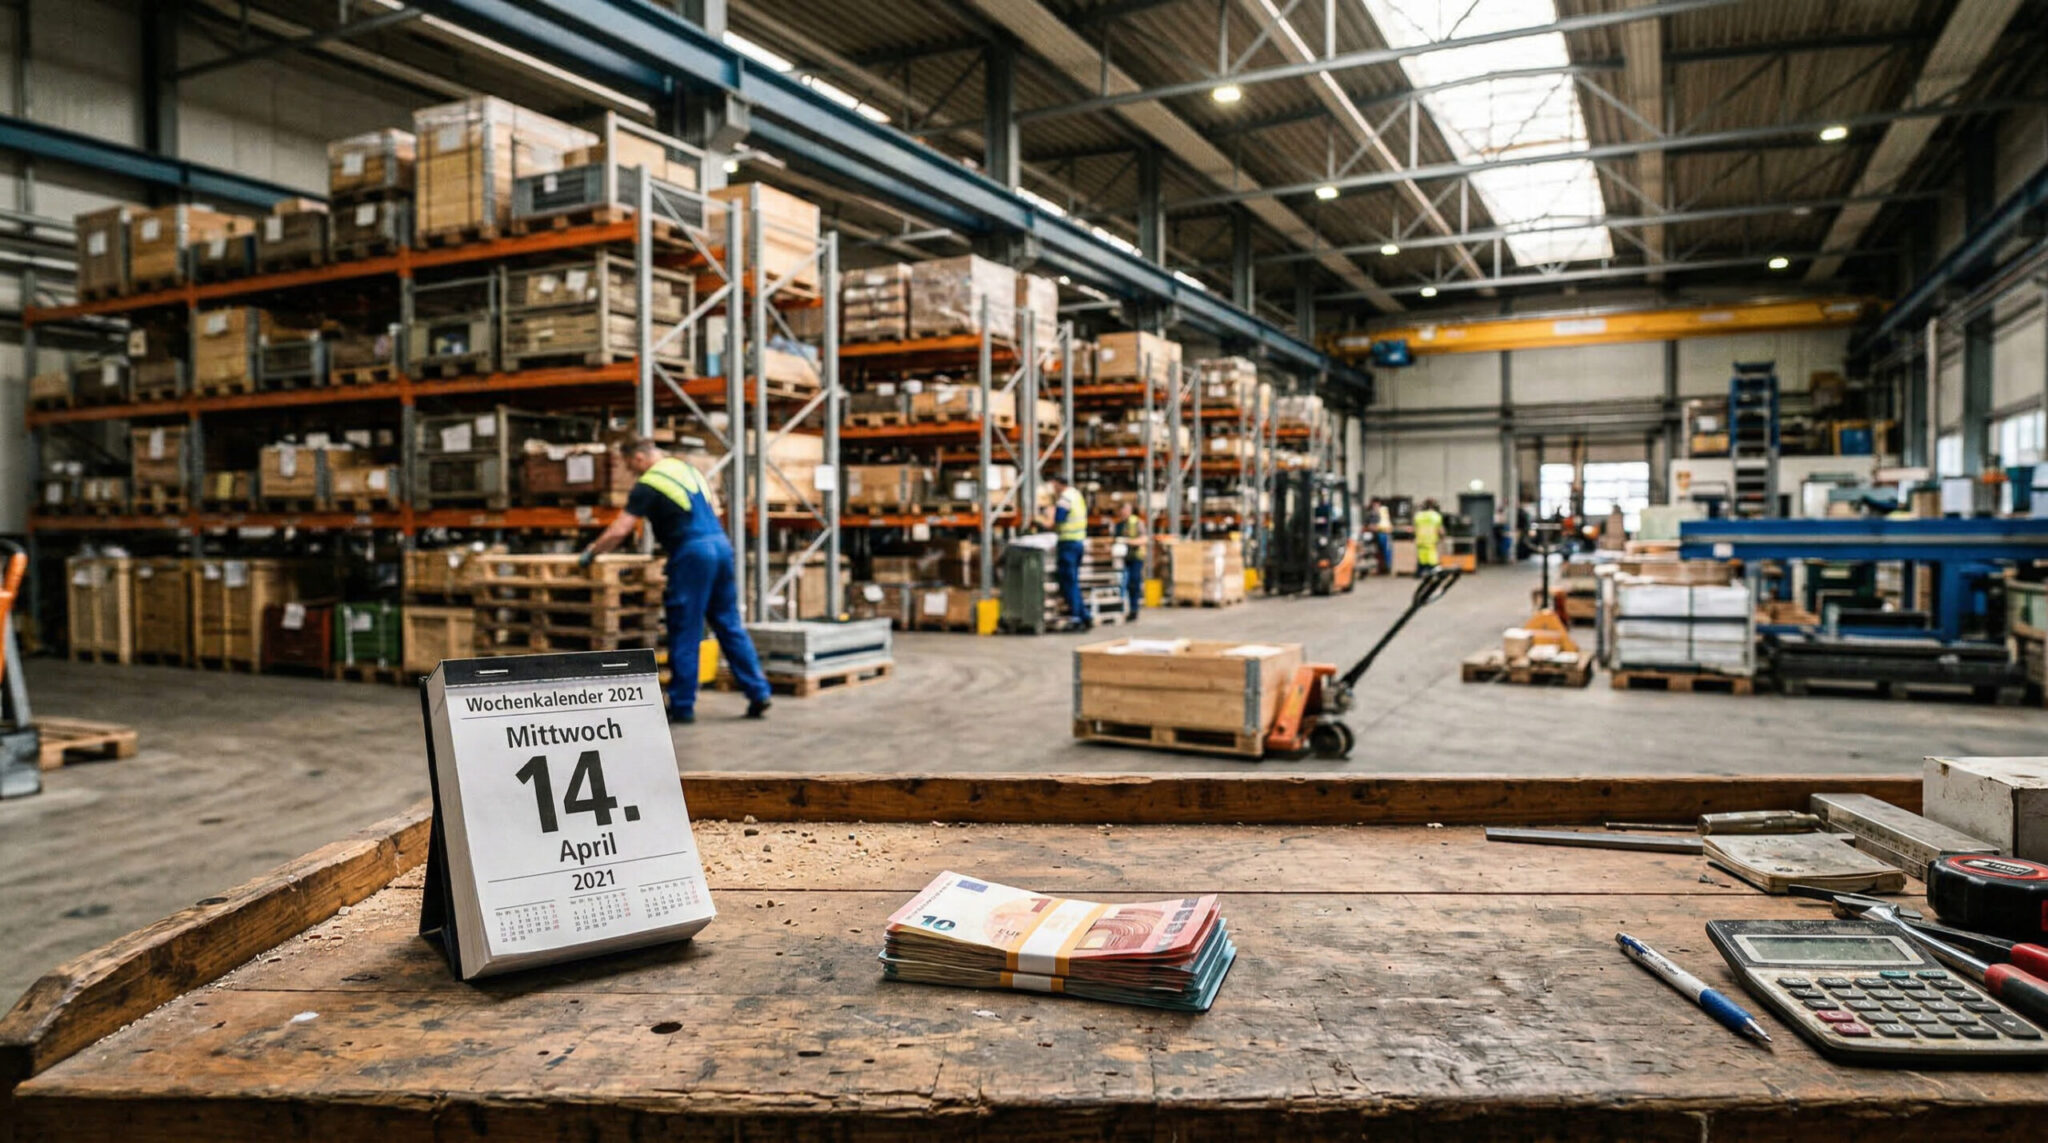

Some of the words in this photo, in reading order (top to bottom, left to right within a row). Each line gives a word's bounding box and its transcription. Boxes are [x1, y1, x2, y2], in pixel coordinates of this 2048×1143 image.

[465, 690, 604, 712] Wochenkalender
[608, 686, 644, 702] 2021
[506, 717, 623, 749] Mittwoch
[515, 750, 641, 834] 14.
[559, 832, 617, 866] April
[572, 870, 616, 891] 2021
[920, 915, 956, 931] 10
